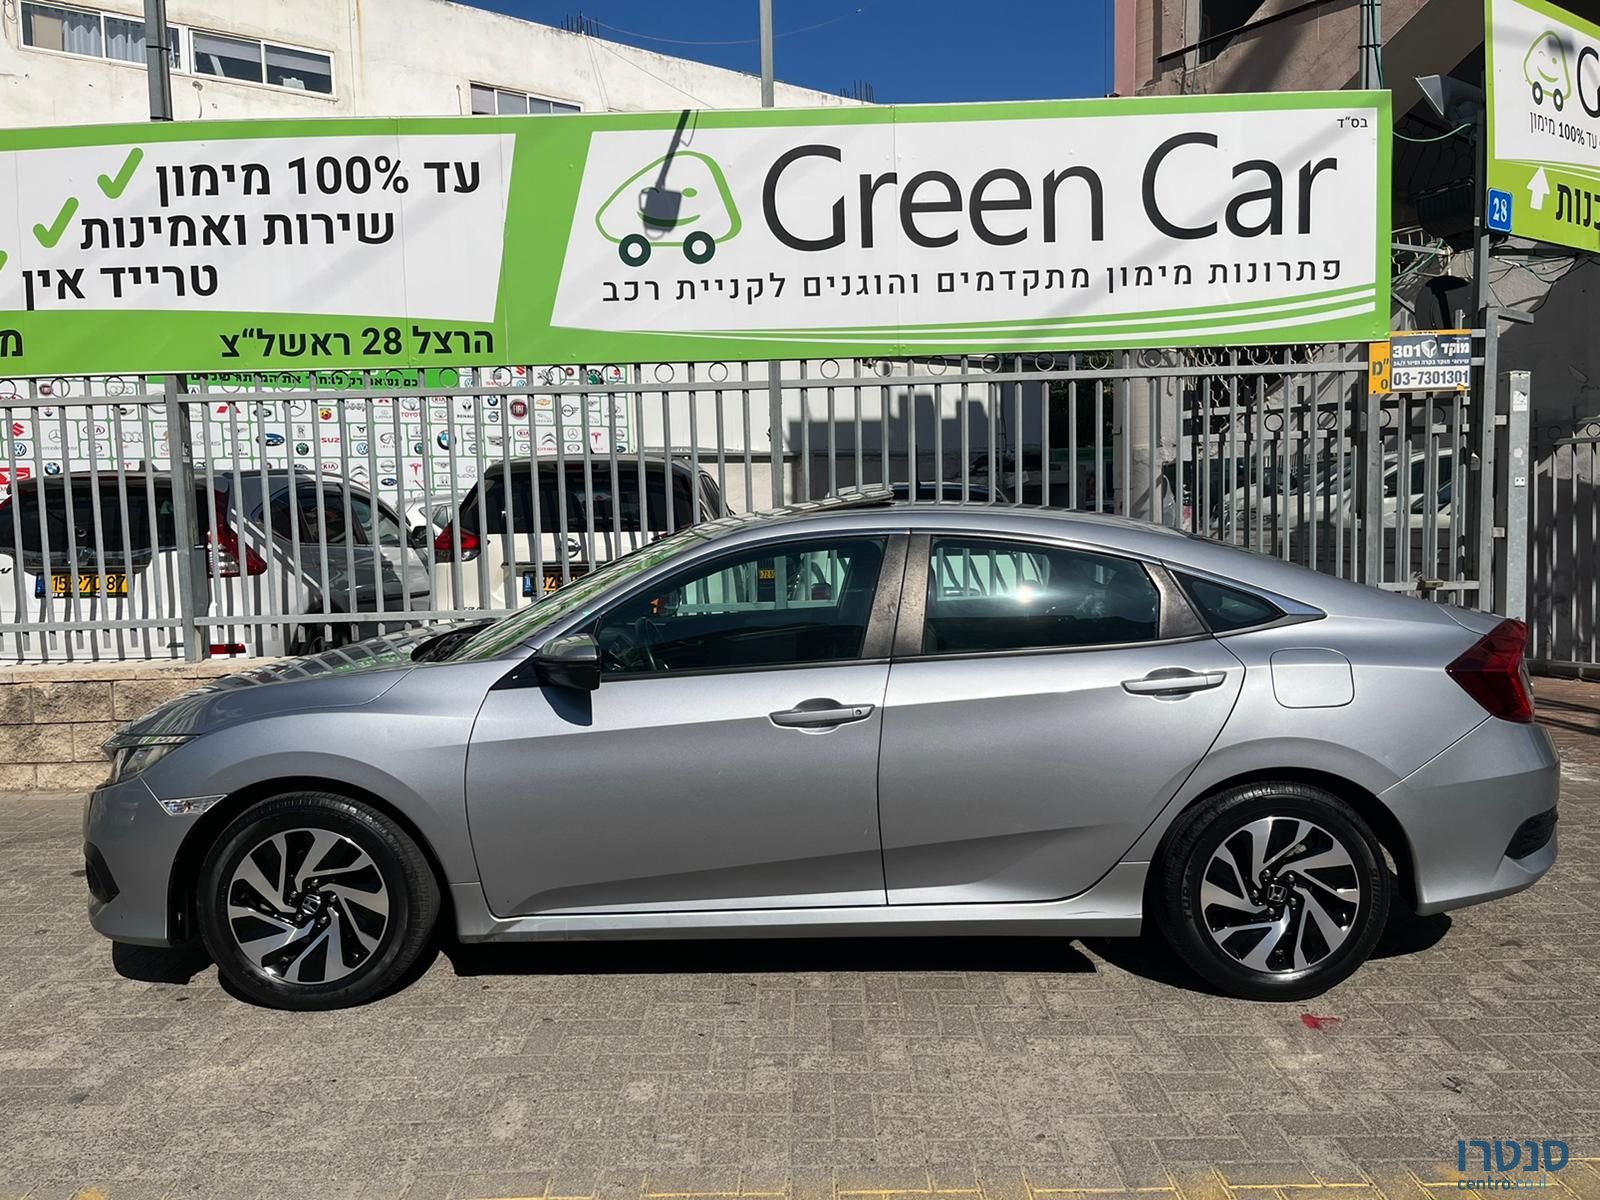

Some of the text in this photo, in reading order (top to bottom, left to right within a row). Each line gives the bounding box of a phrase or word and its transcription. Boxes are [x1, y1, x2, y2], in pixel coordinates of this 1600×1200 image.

[1530, 111, 1597, 149] עד 100% מימון
[155, 155, 481, 208] עד 100% מימון
[761, 131, 1338, 252] Green Car
[1492, 196, 1508, 223] 28
[79, 211, 395, 250] שירות ואמינות
[21, 263, 219, 311] טרייד אין
[602, 259, 1342, 305] פתרונות מימון מתקדמים והוגנים לקניית רכב
[362, 326, 402, 356] 28
[410, 325, 494, 355] הרצל
[1392, 344, 1421, 359] 301
[1393, 370, 1469, 386] 03-7301301
